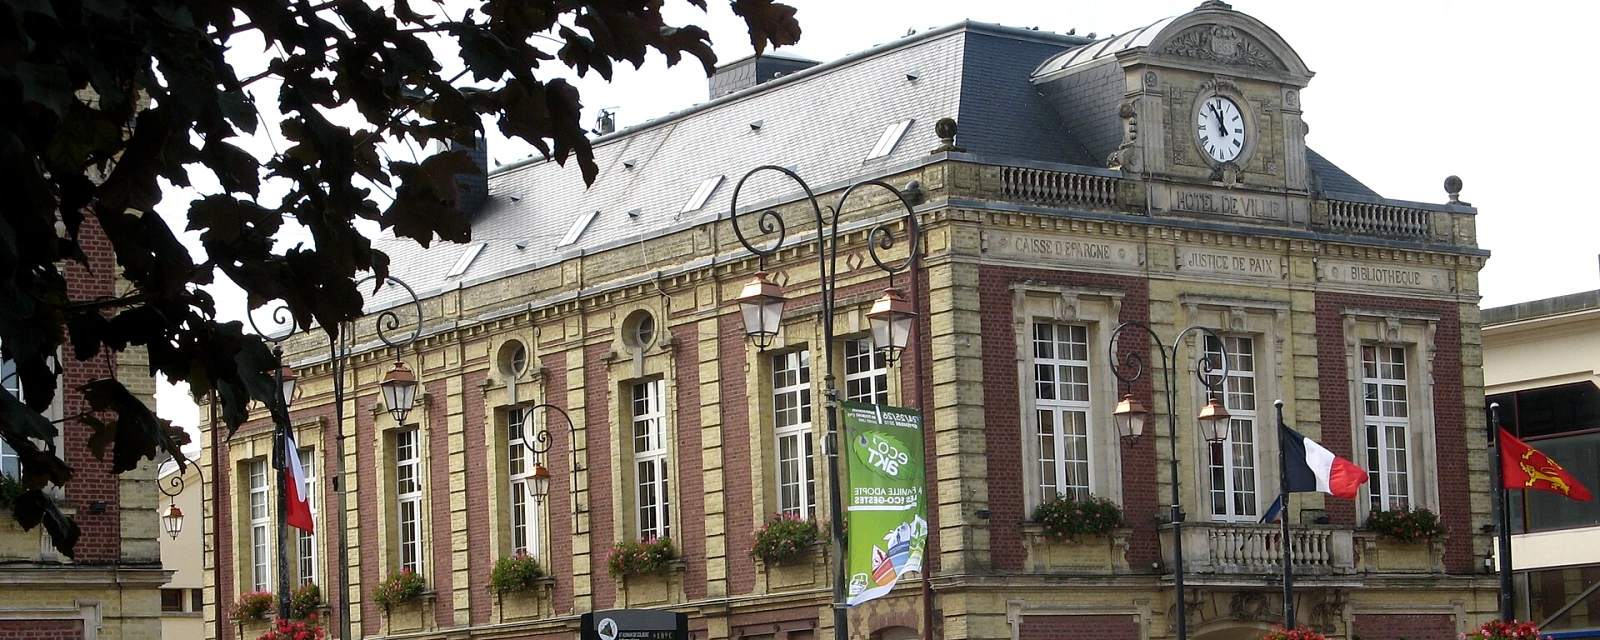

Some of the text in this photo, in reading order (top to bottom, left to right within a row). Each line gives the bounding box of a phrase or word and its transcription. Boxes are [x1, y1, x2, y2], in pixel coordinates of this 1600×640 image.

[1176, 190, 1279, 219] HOTEL DE VILLE
[1015, 236, 1053, 255] CAISSE
[1188, 252, 1273, 274] JUSTICE DE PAIX
[1350, 266, 1421, 286] BIBLIOTHEQUE
